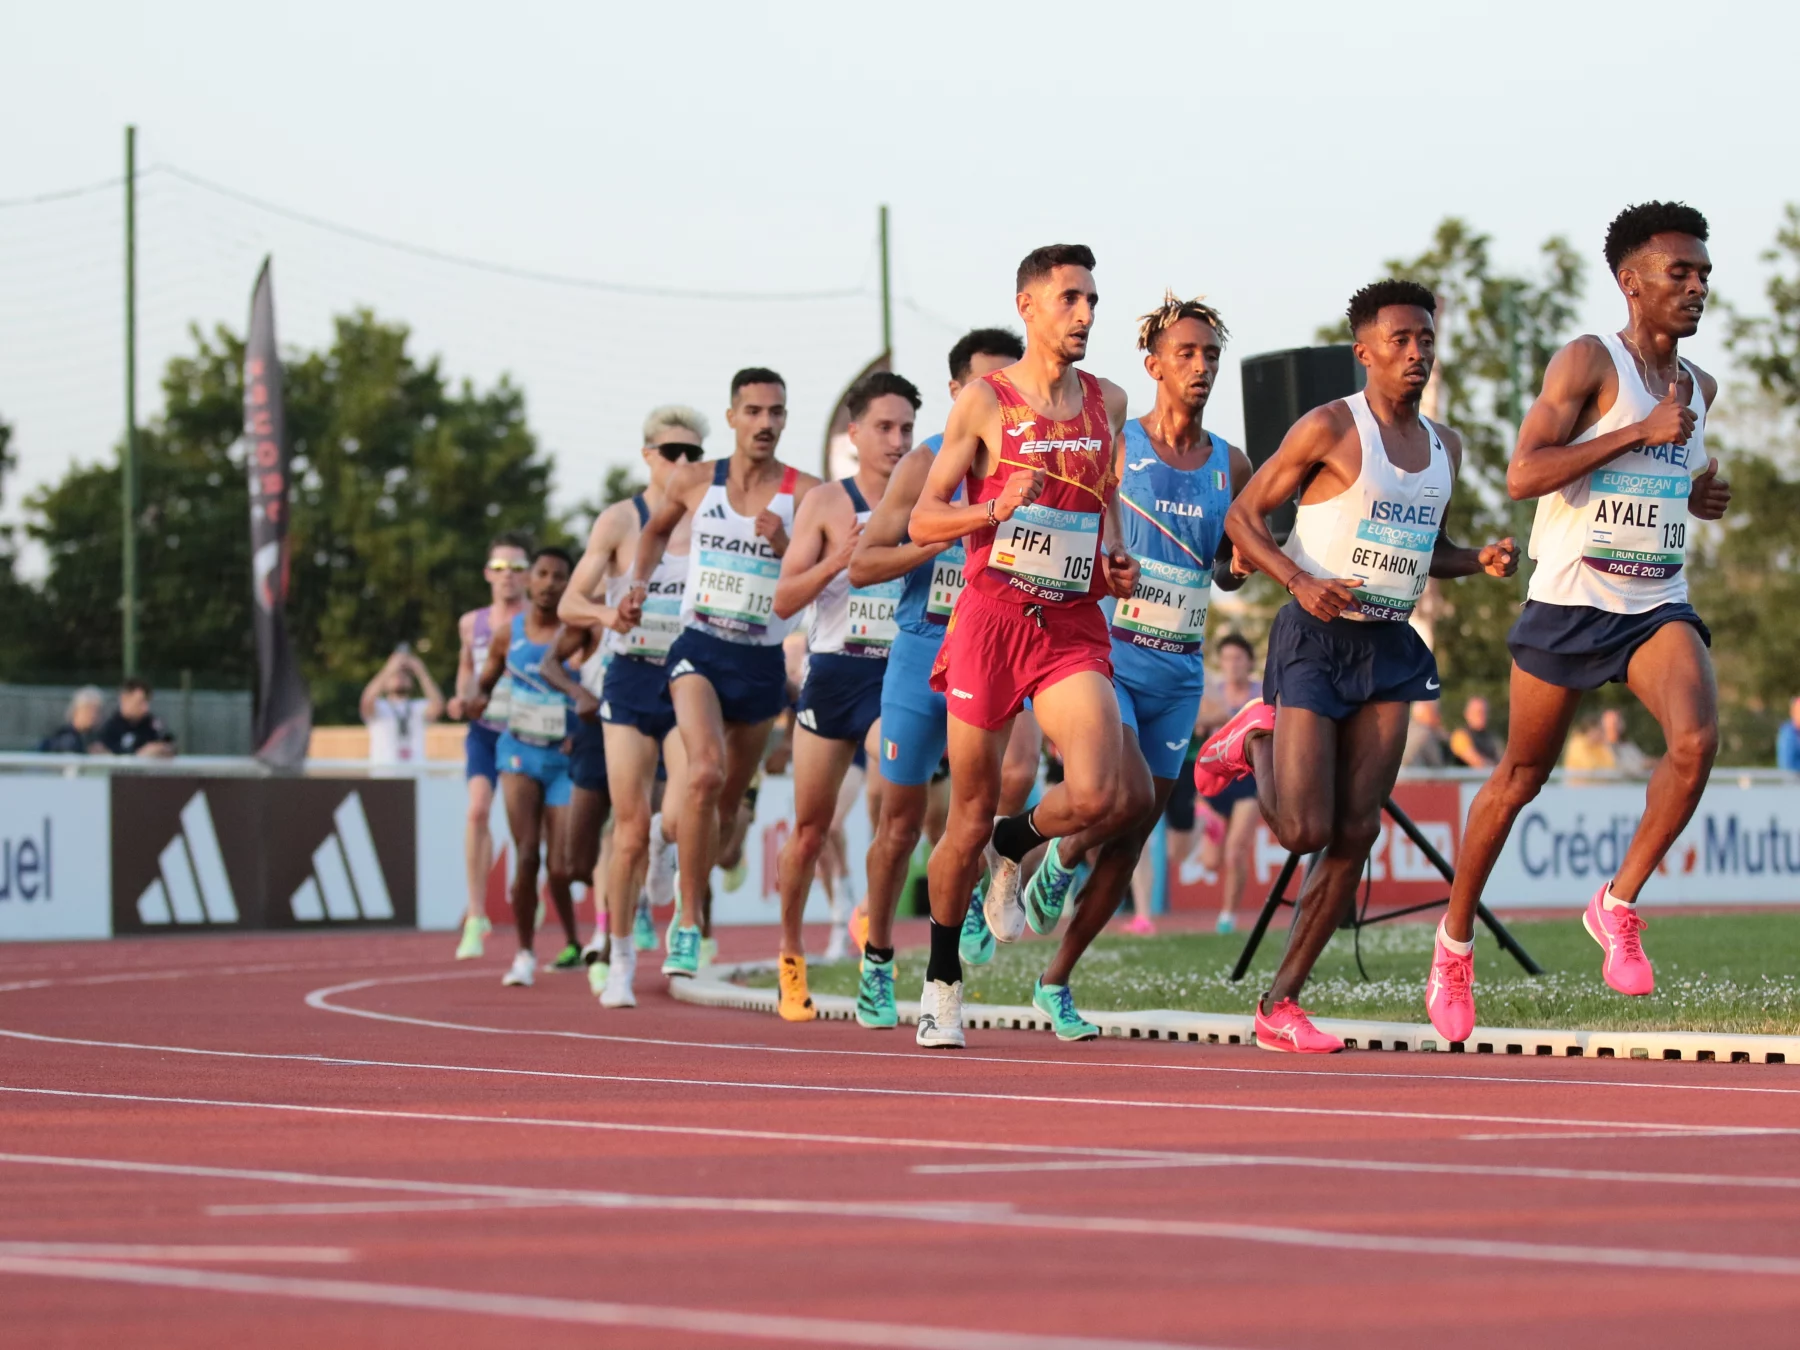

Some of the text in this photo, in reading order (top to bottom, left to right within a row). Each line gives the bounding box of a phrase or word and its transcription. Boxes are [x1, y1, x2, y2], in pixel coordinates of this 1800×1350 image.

[1019, 437, 1102, 454] ESPAÑA
[1631, 444, 1690, 469] RAEL
[1602, 474, 1672, 490] EUROPEAN
[1015, 505, 1078, 525] UROPEAN
[1155, 500, 1203, 518] ITALIA
[1371, 501, 1436, 526] ISRAEL
[1595, 499, 1658, 528] AYALE
[1011, 526, 1051, 556] FIFA
[1367, 523, 1430, 545] EUROPEAN
[1664, 523, 1685, 548] 130
[700, 534, 775, 559] FRANC
[1616, 551, 1634, 560] RUN
[1064, 556, 1092, 580] 105
[1140, 557, 1200, 582] EUROPEAN
[1352, 547, 1418, 577] GETAHON
[1608, 563, 1665, 577] PACÉ 2023
[1009, 577, 1063, 602] PACÉ 2023
[1133, 583, 1187, 610] RIPPA Y.
[1371, 595, 1387, 604] RUN
[747, 592, 773, 614] 113
[1361, 604, 1390, 619] PACÉ
[1189, 607, 1206, 628] 138
[1142, 625, 1158, 635] RUN
[1132, 634, 1184, 653] PACÉ 2023
